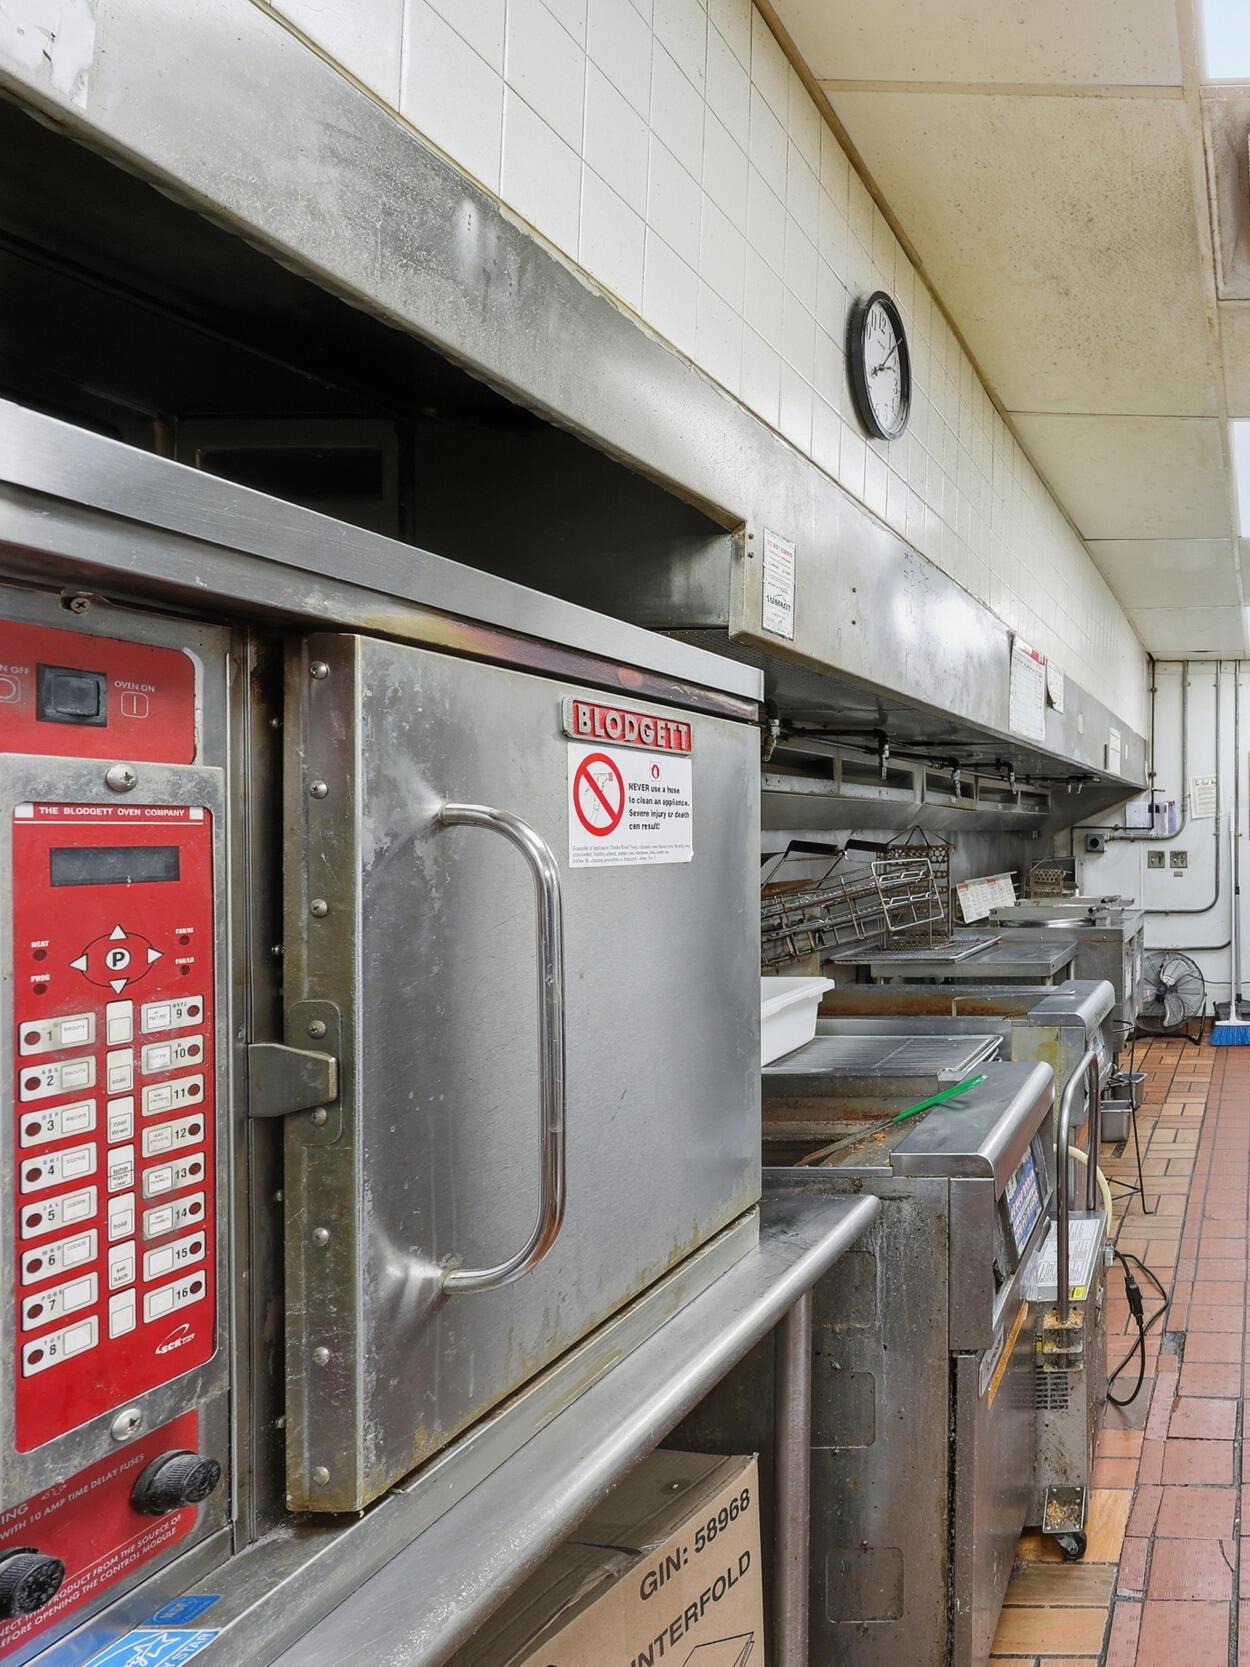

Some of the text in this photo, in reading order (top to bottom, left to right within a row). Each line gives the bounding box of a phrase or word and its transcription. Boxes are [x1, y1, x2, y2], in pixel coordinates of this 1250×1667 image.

[11, 666, 30, 674] OFF
[114, 680, 139, 690] OVEN
[577, 703, 689, 750] BLODGETT
[628, 782, 650, 792] NEVER
[650, 785, 661, 793] use
[666, 786, 680, 794] hose
[628, 796, 636, 804] to
[636, 796, 653, 805] clean
[662, 798, 690, 807] appliance.
[39, 806, 185, 817] THE BLODGETT OVEN COMPANY
[628, 808, 650, 818] Severe
[650, 809, 667, 819] injury
[674, 811, 690, 819] death
[31, 940, 49, 948] HEAT
[112, 951, 125, 967] P
[30, 974, 50, 982] PROG
[176, 1008, 182, 1018] 9
[47, 1031, 52, 1041] 1
[174, 1048, 186, 1059] 10
[46, 1075, 54, 1086] 2
[174, 1088, 185, 1099] 11
[47, 1119, 54, 1131] 3
[175, 1128, 186, 1140] 12
[47, 1165, 54, 1175] 4
[48, 1210, 55, 1220] 5
[175, 1208, 187, 1220] 14
[113, 1220, 128, 1230] hold
[48, 1254, 55, 1265] 6
[176, 1248, 187, 1260] 15
[176, 1288, 188, 1300] 16
[49, 1299, 56, 1310] 7
[49, 1344, 56, 1355] 8
[0, 1453, 145, 1540] WITH 10 AMP TIME DELAY FUSES
[92, 1556, 118, 1576] FROM
[120, 1545, 136, 1559] THE
[137, 1522, 171, 1549] SOURCE
[170, 1514, 182, 1527] OF
[639, 1488, 750, 1600] GIN: 58968
[0, 1527, 177, 1649] EFORE OPENING THE CONTROL MODULE
[175, 1633, 215, 1660] STAR
